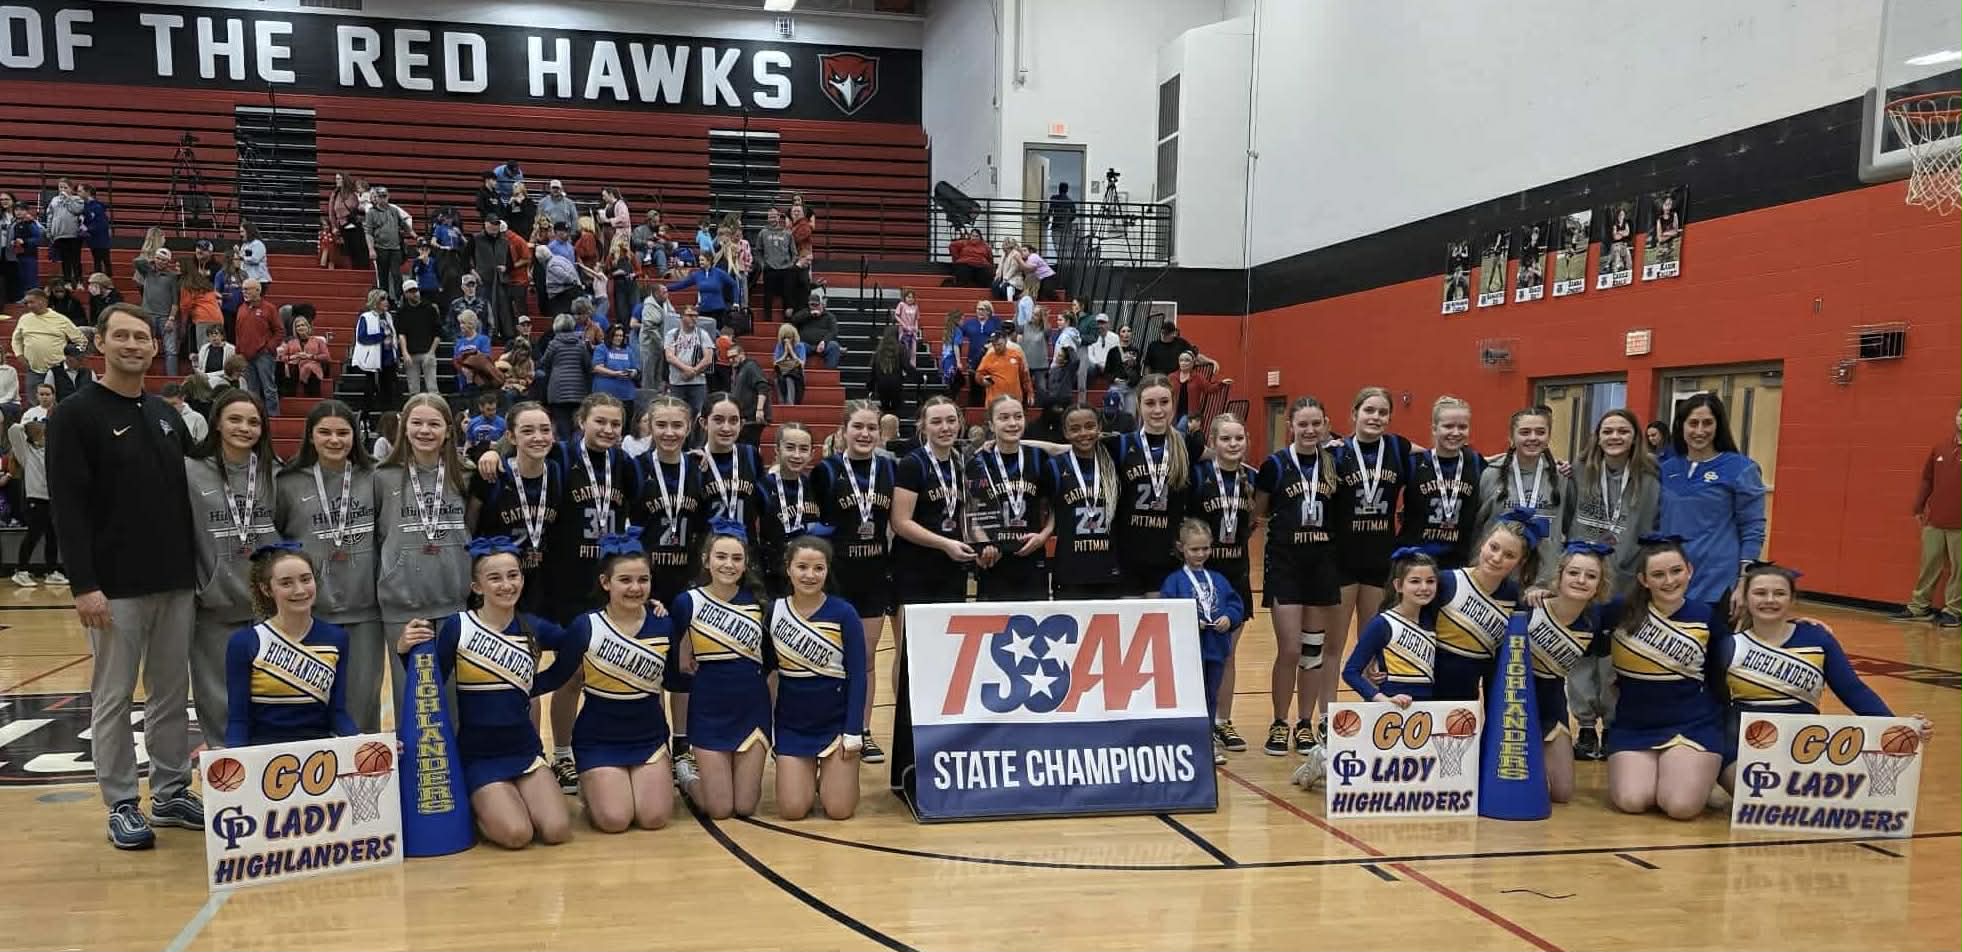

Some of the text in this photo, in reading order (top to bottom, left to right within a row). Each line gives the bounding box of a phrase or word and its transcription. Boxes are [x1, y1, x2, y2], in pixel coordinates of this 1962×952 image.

[0, 6, 793, 109] OF THE RED HAWKS
[1130, 515, 1168, 529] PITTMAN
[1352, 519, 1389, 533] PITTMAN
[1423, 528, 1460, 542] PITTMAN
[579, 544, 603, 559] PITT
[1073, 539, 1111, 553] PITTMAN
[1211, 547, 1243, 559] ITTMAN
[773, 617, 834, 668] HIGHLANDERS
[1634, 620, 1698, 667] IGHLANDERS
[264, 640, 335, 693] HIGHLANDERS
[940, 612, 1178, 716] TSSAA
[1741, 648, 1820, 693] HIGHLANDERS
[1497, 634, 1530, 781] HIGHLANDERS
[415, 652, 456, 815] HIGHLANDERS
[1372, 710, 1434, 751] GO
[1790, 724, 1866, 766] GO
[261, 749, 340, 802] GO
[933, 744, 1196, 791] STATE CHAMPIONS
[1371, 755, 1437, 783] LADY
[1785, 770, 1867, 799] LADY
[264, 800, 348, 840] LADY
[1331, 790, 1474, 815] HIGHLANDERS
[1735, 803, 1910, 833] HIGHLANDERS
[214, 833, 397, 886] HIGHLANDERS
